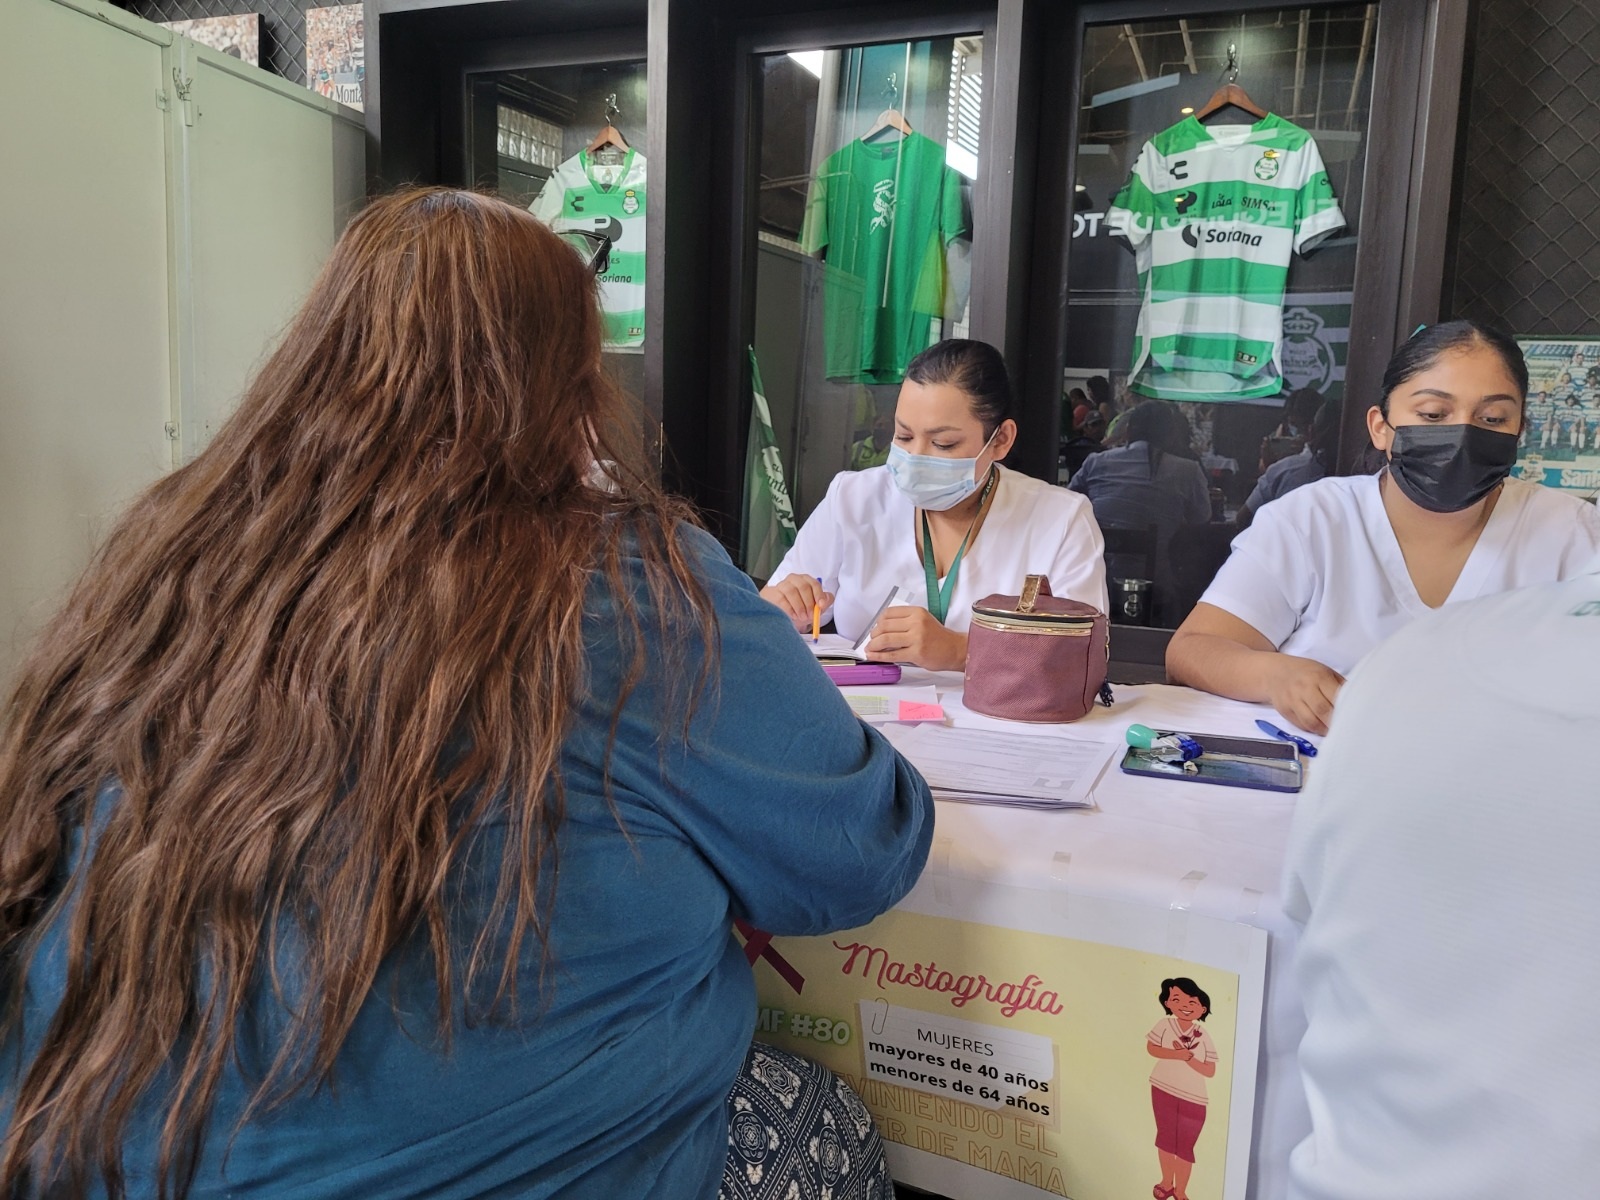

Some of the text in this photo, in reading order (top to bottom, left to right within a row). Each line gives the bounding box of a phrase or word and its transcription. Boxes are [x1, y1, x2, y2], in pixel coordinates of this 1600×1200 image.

[1205, 226, 1263, 247] Soriana
[597, 273, 632, 284] Soriana
[832, 940, 1064, 1018] Mastografía
[789, 1013, 851, 1046] #80
[916, 1027, 995, 1057] MUJERES
[868, 1040, 1050, 1093] mayores de 40 años
[869, 1060, 1051, 1116] menores de 64 años
[1014, 1117, 1058, 1158] EL
[916, 1125, 959, 1161] DE
[968, 1140, 1068, 1198] MAMA
